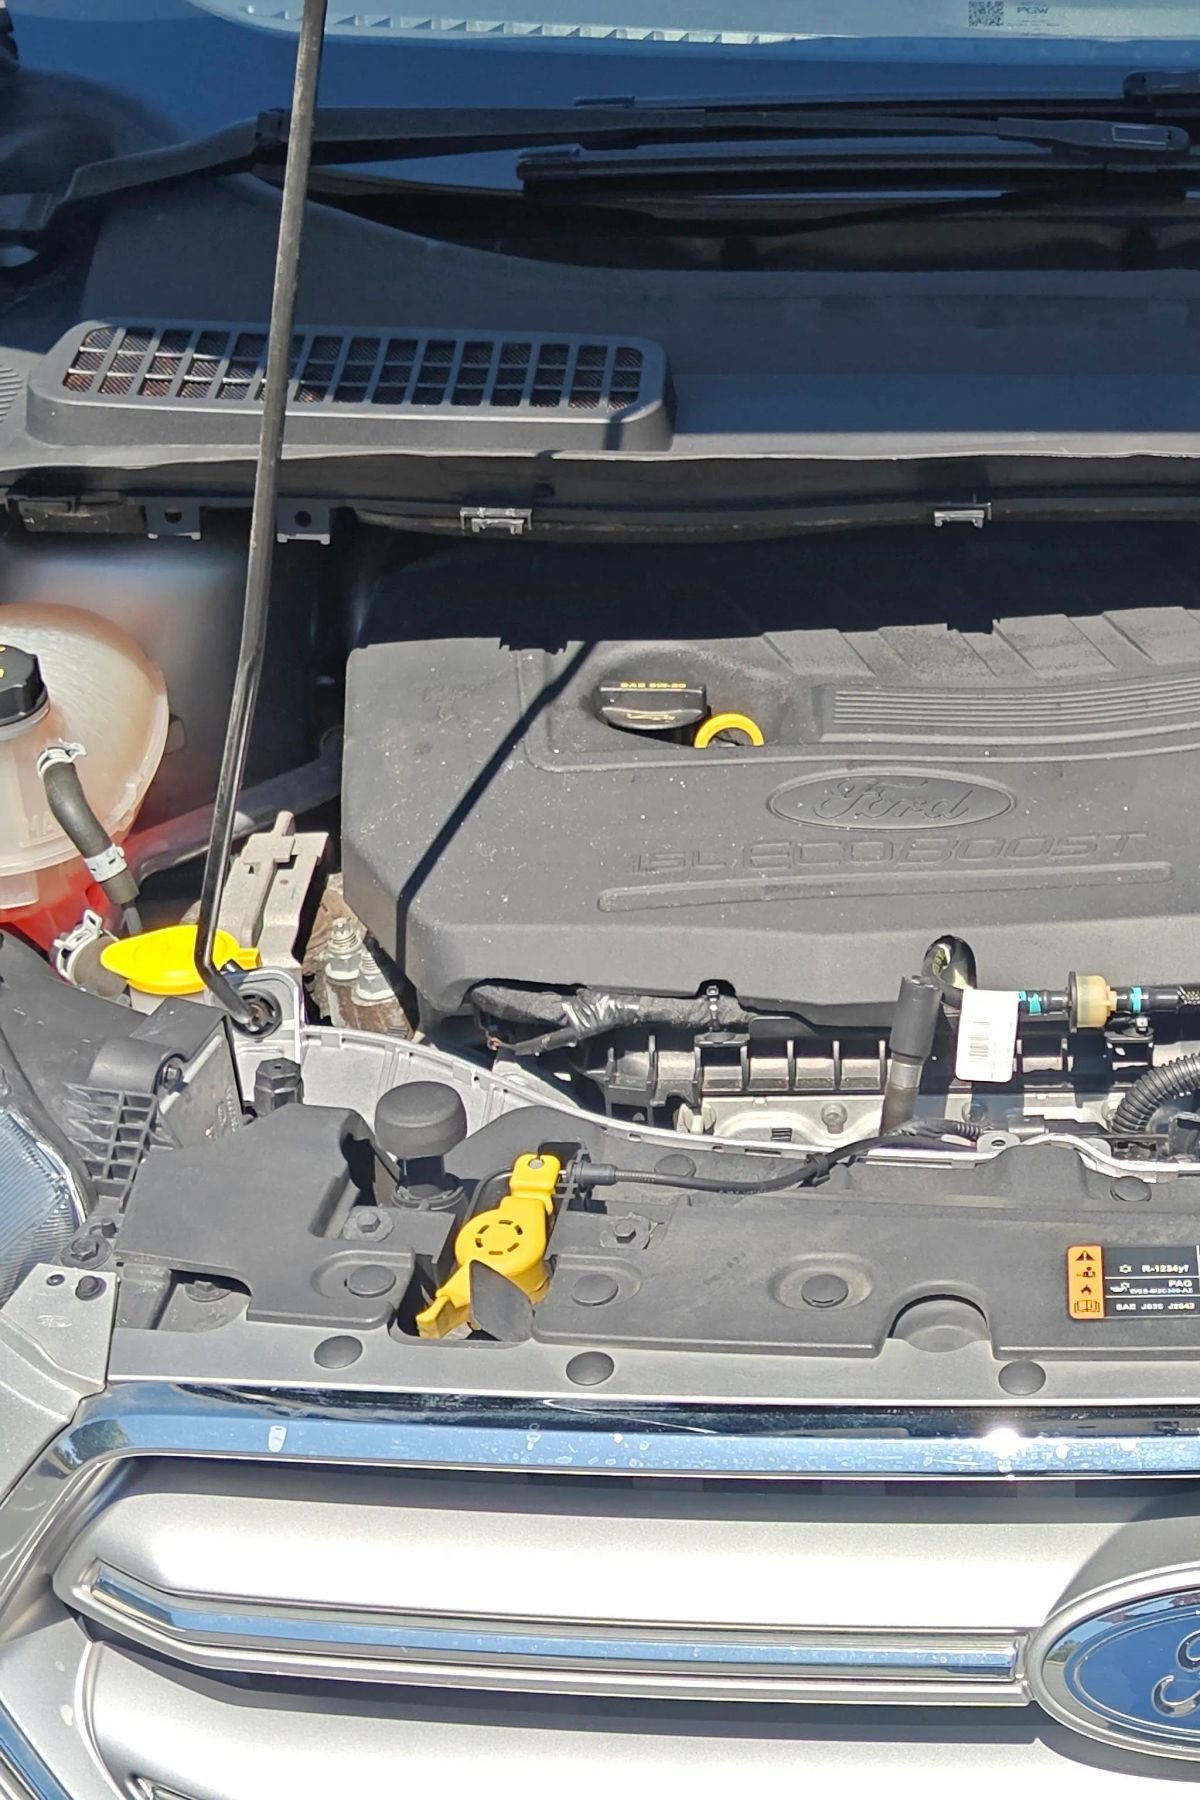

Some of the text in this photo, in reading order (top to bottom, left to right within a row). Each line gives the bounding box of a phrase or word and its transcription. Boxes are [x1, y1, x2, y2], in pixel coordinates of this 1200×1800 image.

[811, 777, 975, 820] Ford
[1141, 1264, 1189, 1274] R-1234yf
[1168, 1280, 1193, 1288] PAG
[1115, 1303, 1137, 1311] SAE
